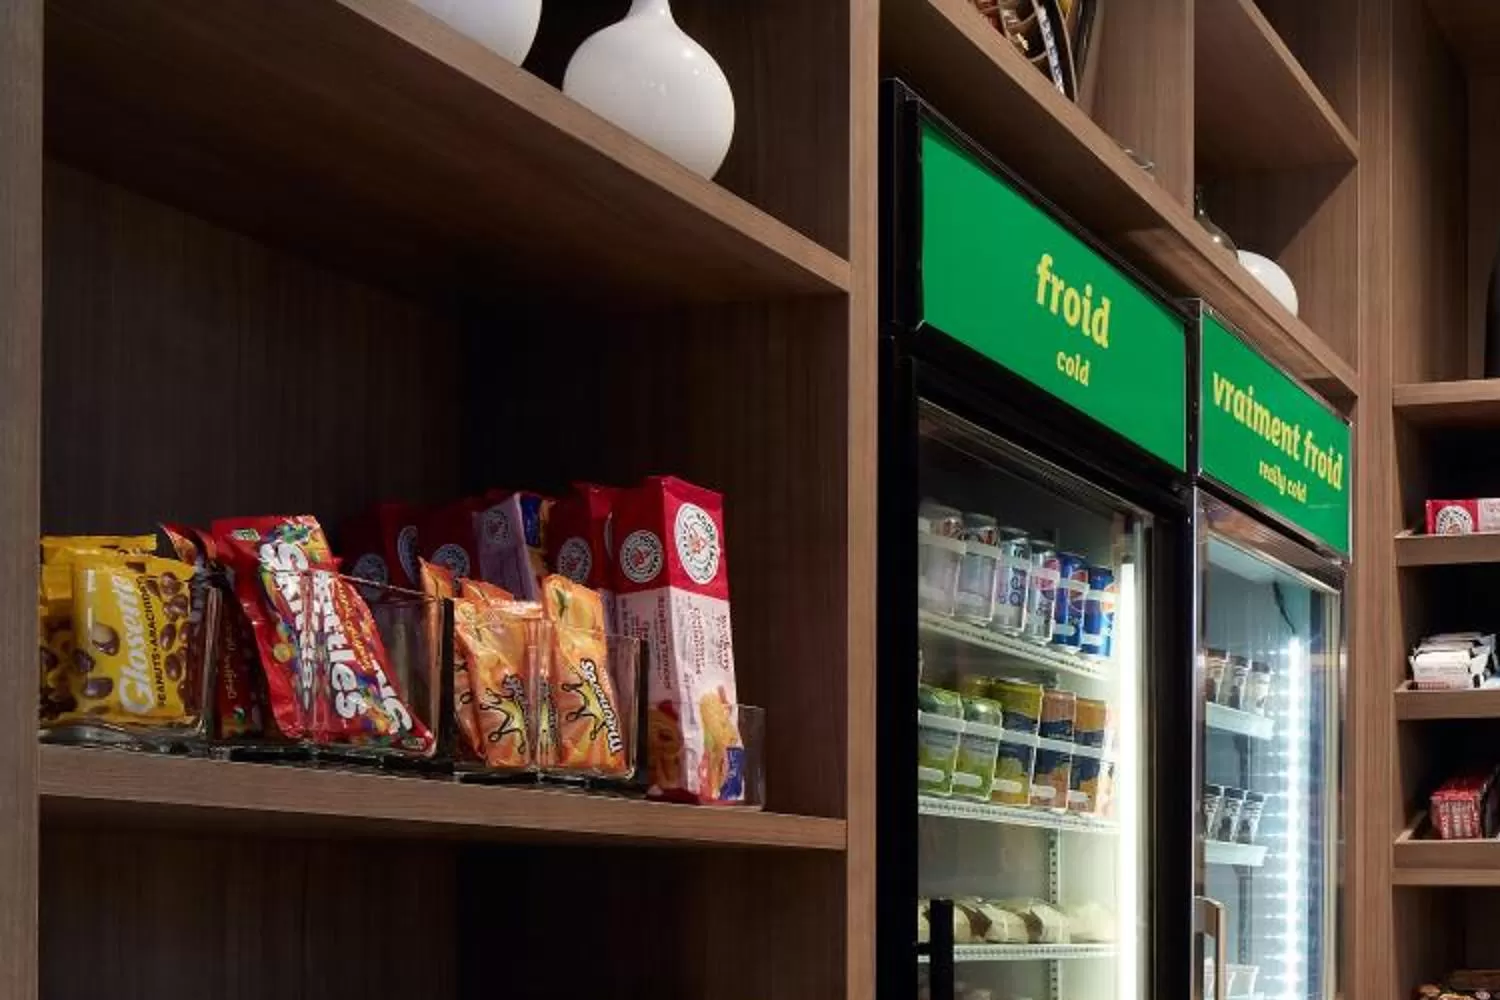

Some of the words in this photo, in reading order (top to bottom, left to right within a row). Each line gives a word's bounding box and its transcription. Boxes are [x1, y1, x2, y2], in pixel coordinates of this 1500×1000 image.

[1036, 253, 1111, 349] froid
[1057, 351, 1090, 387] cold
[1213, 371, 1301, 461] vraiment
[1304, 430, 1343, 492] froid
[1259, 460, 1287, 495] really
[1288, 480, 1307, 504] cold
